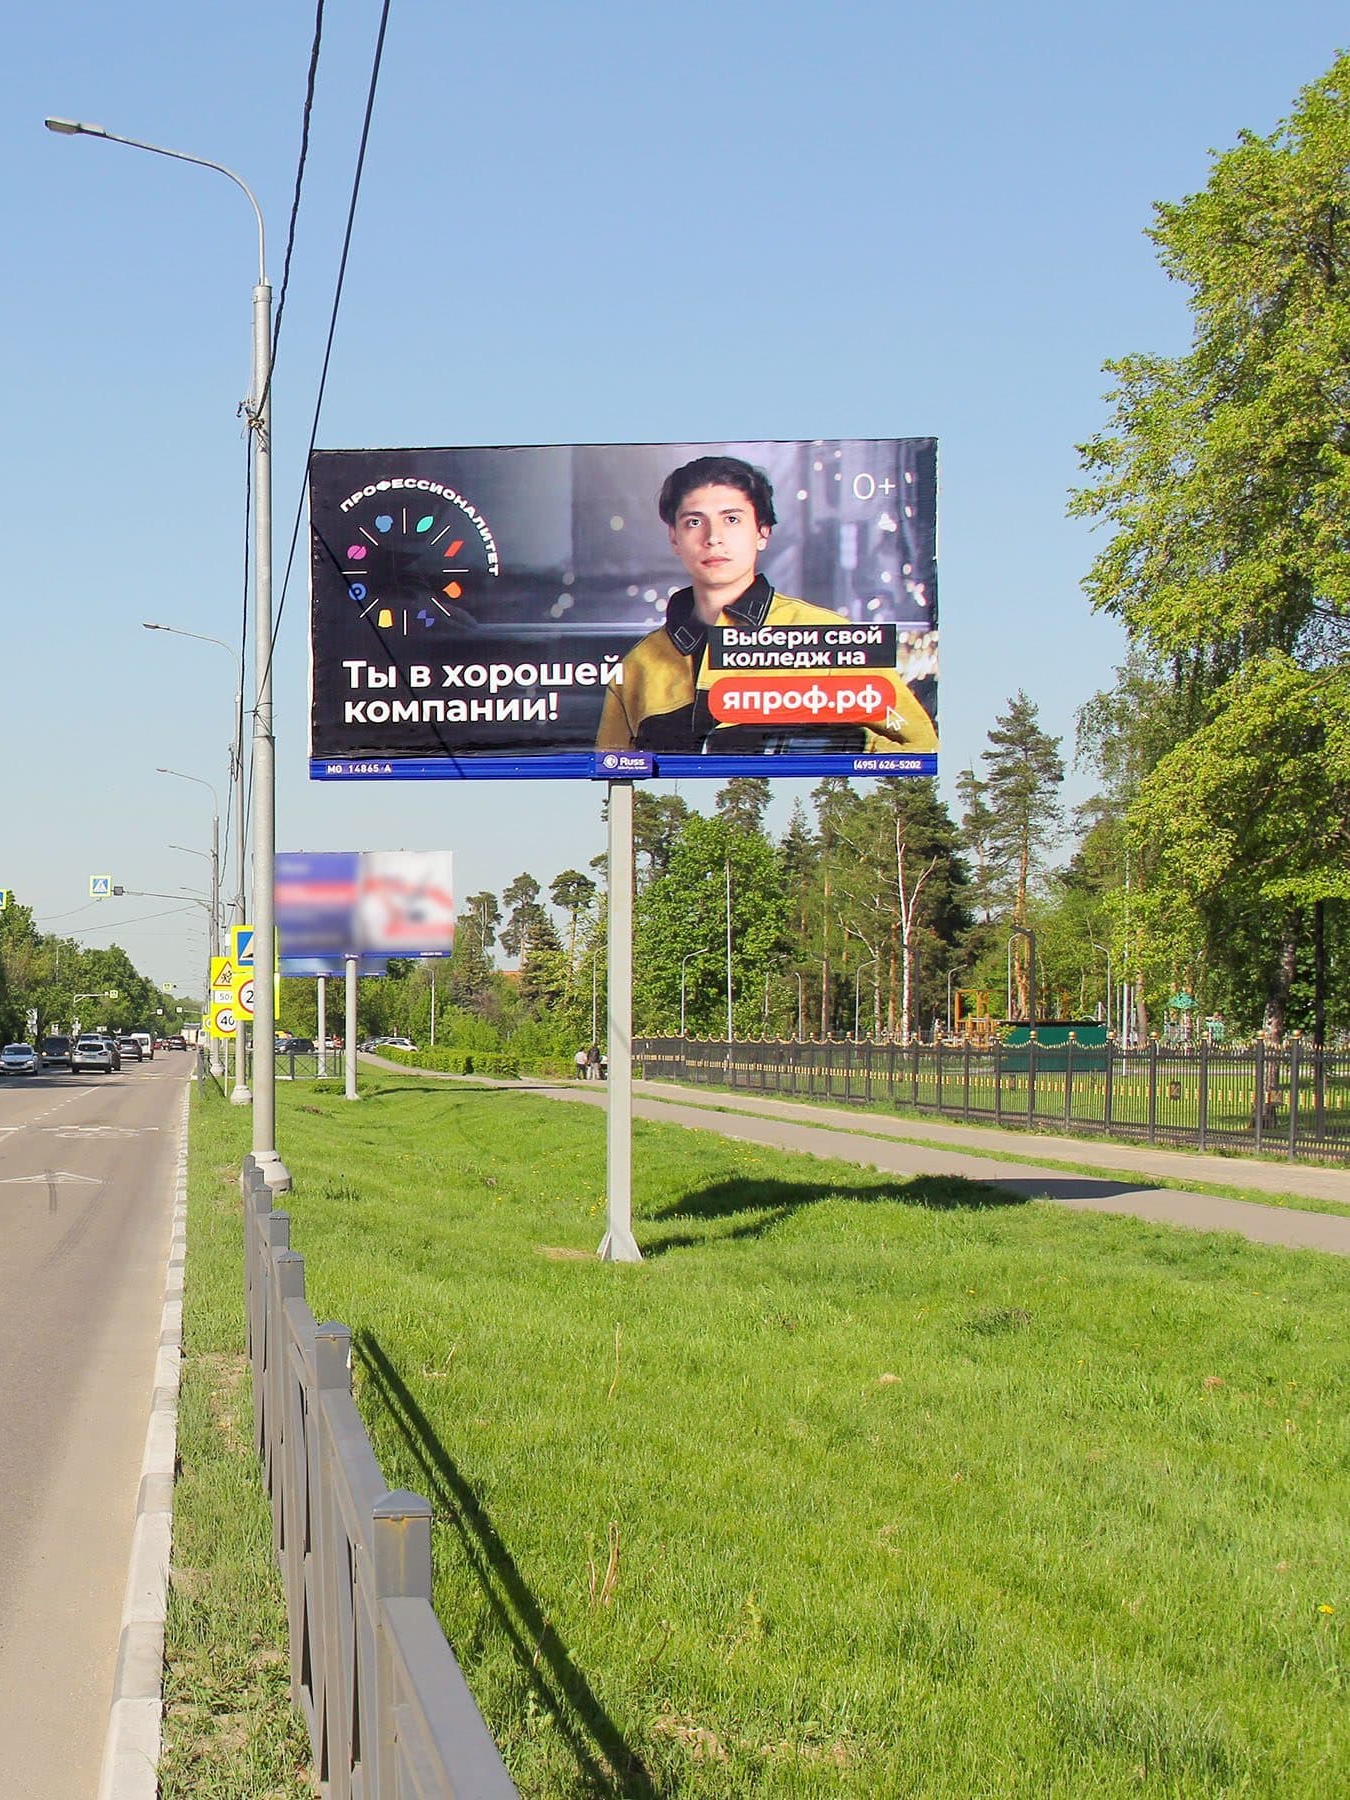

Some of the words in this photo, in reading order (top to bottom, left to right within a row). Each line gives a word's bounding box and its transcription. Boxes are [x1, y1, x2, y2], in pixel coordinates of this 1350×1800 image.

[853, 472, 896, 500] 0+
[339, 478, 499, 577] ПРОФЕССИОНАЛИТЕТ
[722, 626, 818, 649] Выбери
[825, 625, 882, 645] свой
[722, 649, 832, 669] колледж
[837, 649, 866, 665] на
[341, 660, 397, 689] Ты
[410, 665, 431, 687] в
[441, 654, 624, 693] хорошей
[343, 692, 559, 724] компании!
[722, 683, 883, 716] япроф.рф
[348, 764, 380, 773] 14865
[619, 756, 645, 766] Russ
[853, 760, 877, 770] (495)
[878, 760, 922, 769] 626-5202
[246, 990, 254, 1004] 2
[220, 1015, 235, 1026] 40
